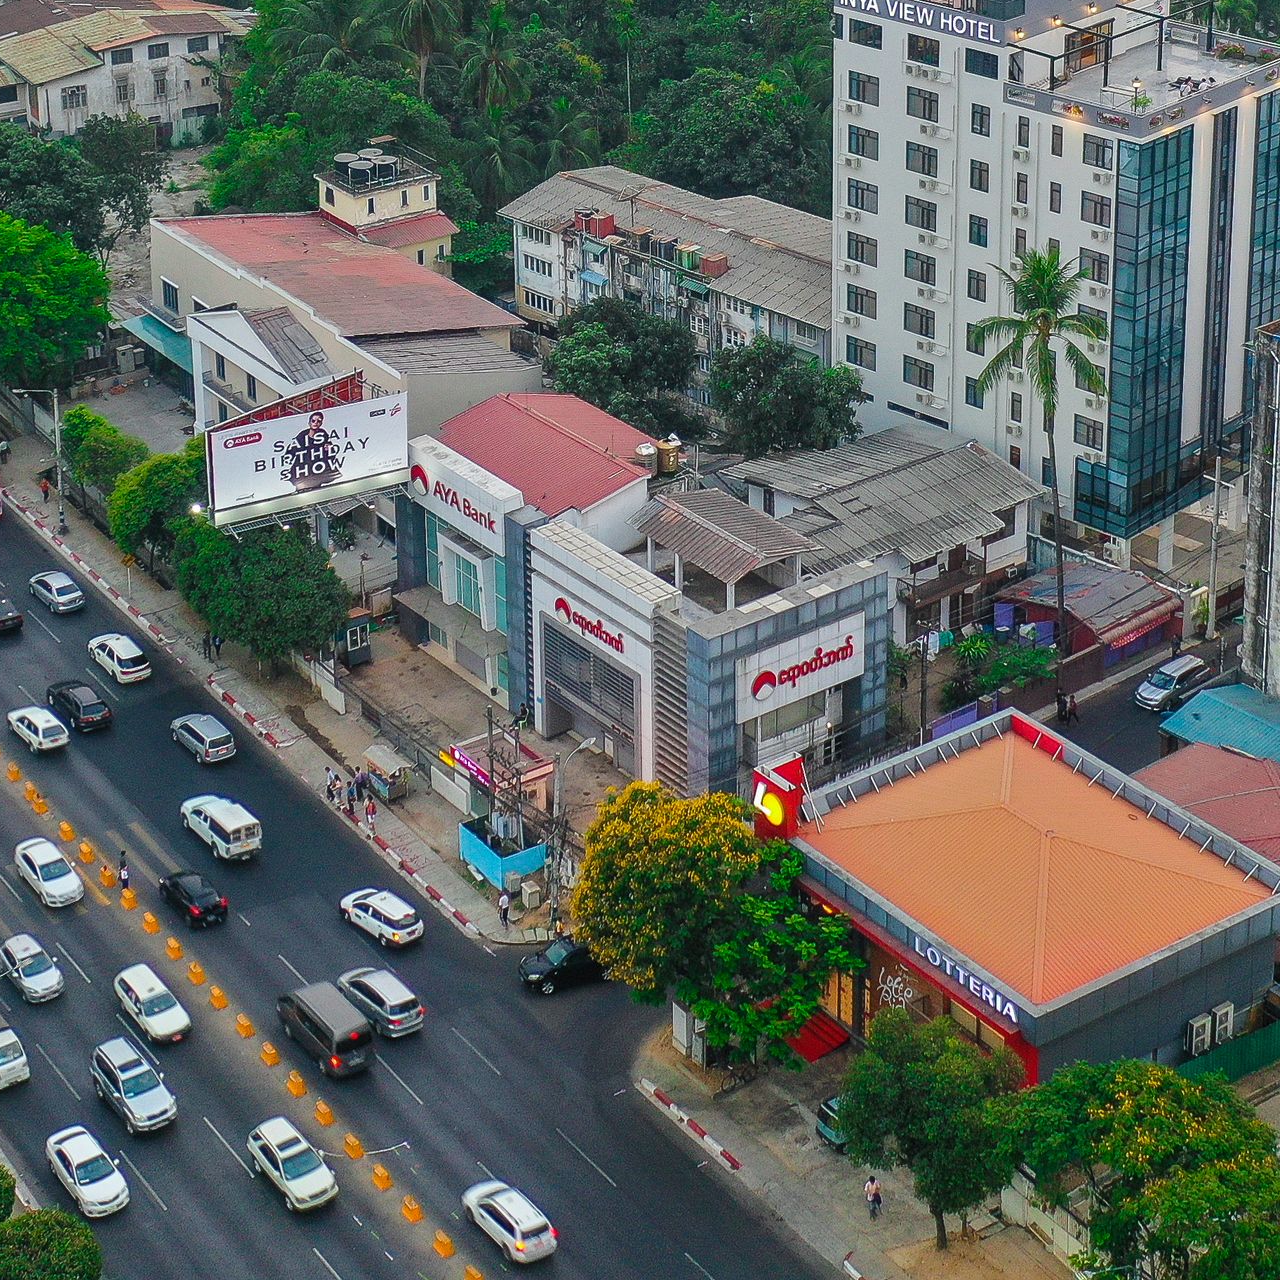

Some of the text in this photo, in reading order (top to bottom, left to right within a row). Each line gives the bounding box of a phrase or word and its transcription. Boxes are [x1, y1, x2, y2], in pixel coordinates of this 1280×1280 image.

[940, 11, 1001, 44] HOTEL
[254, 436, 370, 473] BIRTHDAY
[273, 426, 348, 453] SAISAI
[280, 456, 346, 481] SHOW
[433, 480, 497, 534] AYA Bank
[914, 935, 1019, 1024] LOTTERIA
